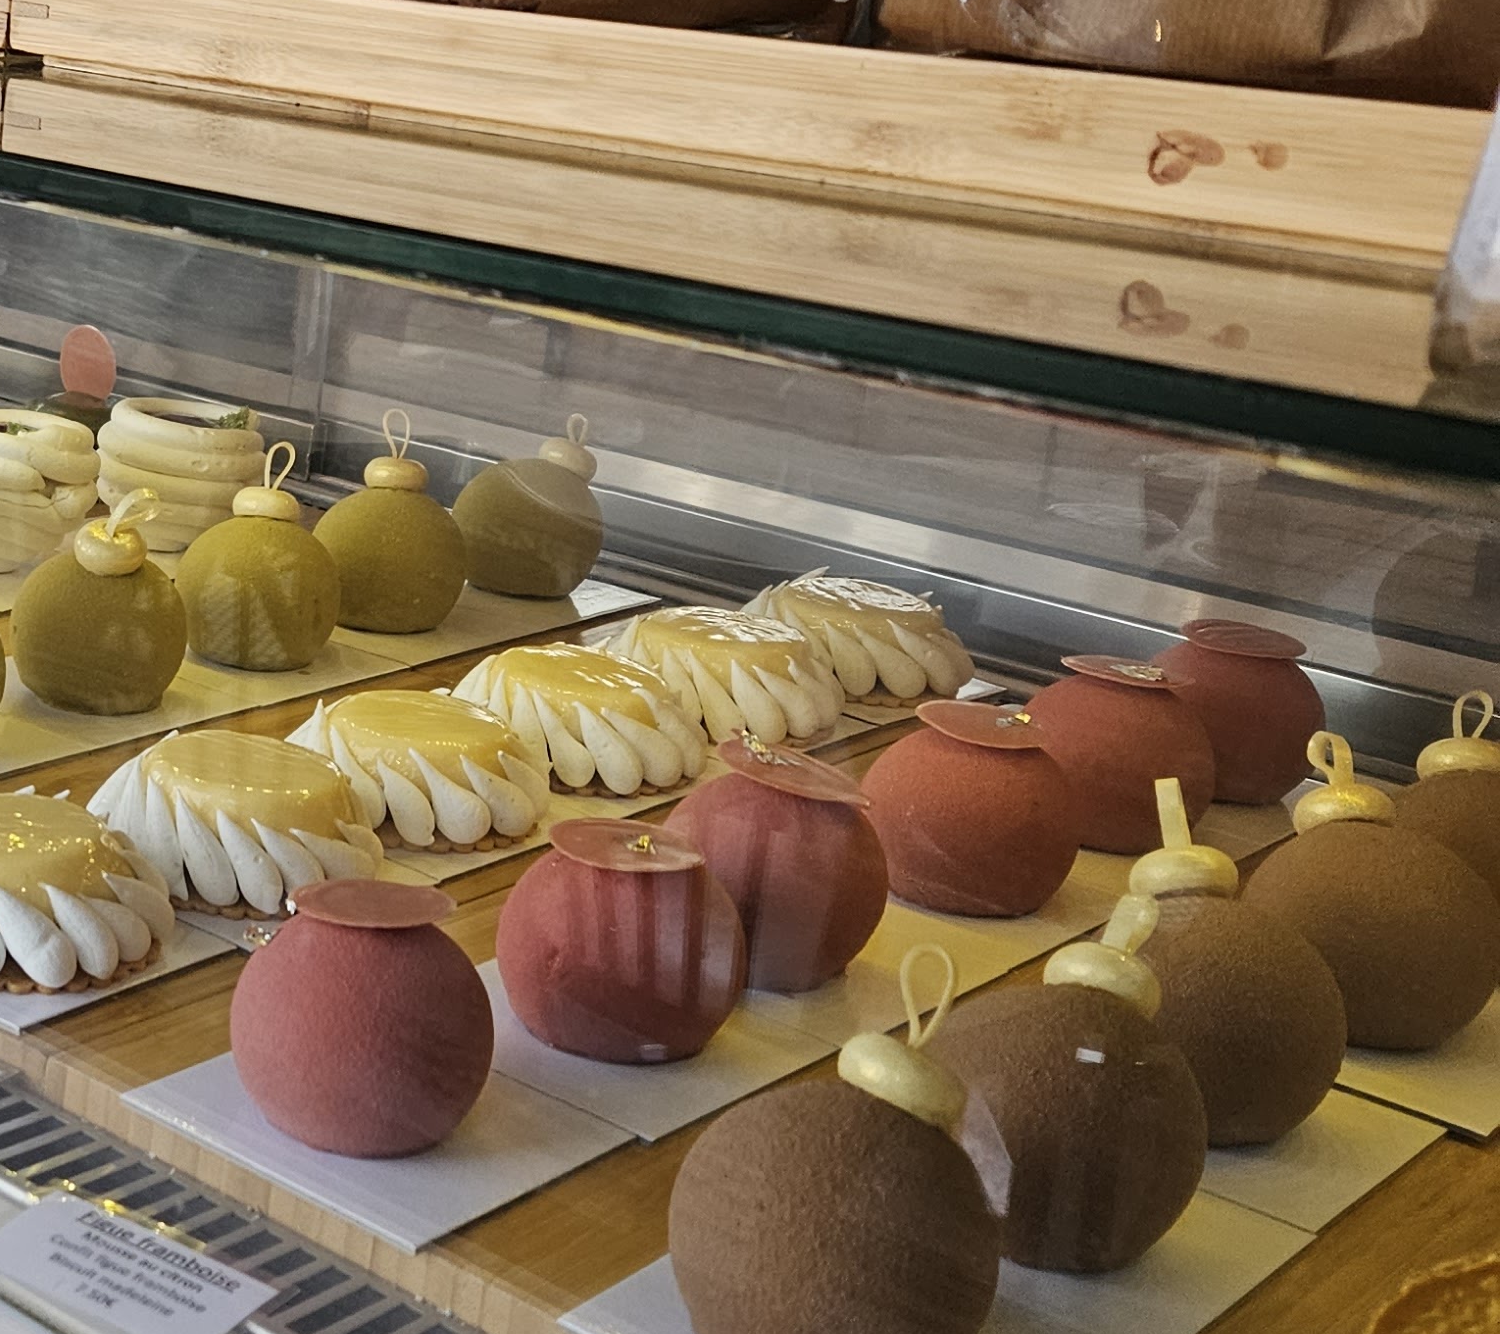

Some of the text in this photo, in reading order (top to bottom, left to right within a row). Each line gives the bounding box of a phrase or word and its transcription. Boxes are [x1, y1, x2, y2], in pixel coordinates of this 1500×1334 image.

[82, 1231, 139, 1261] Mousse
[158, 1269, 204, 1294] citron
[135, 1235, 242, 1293] framboise
